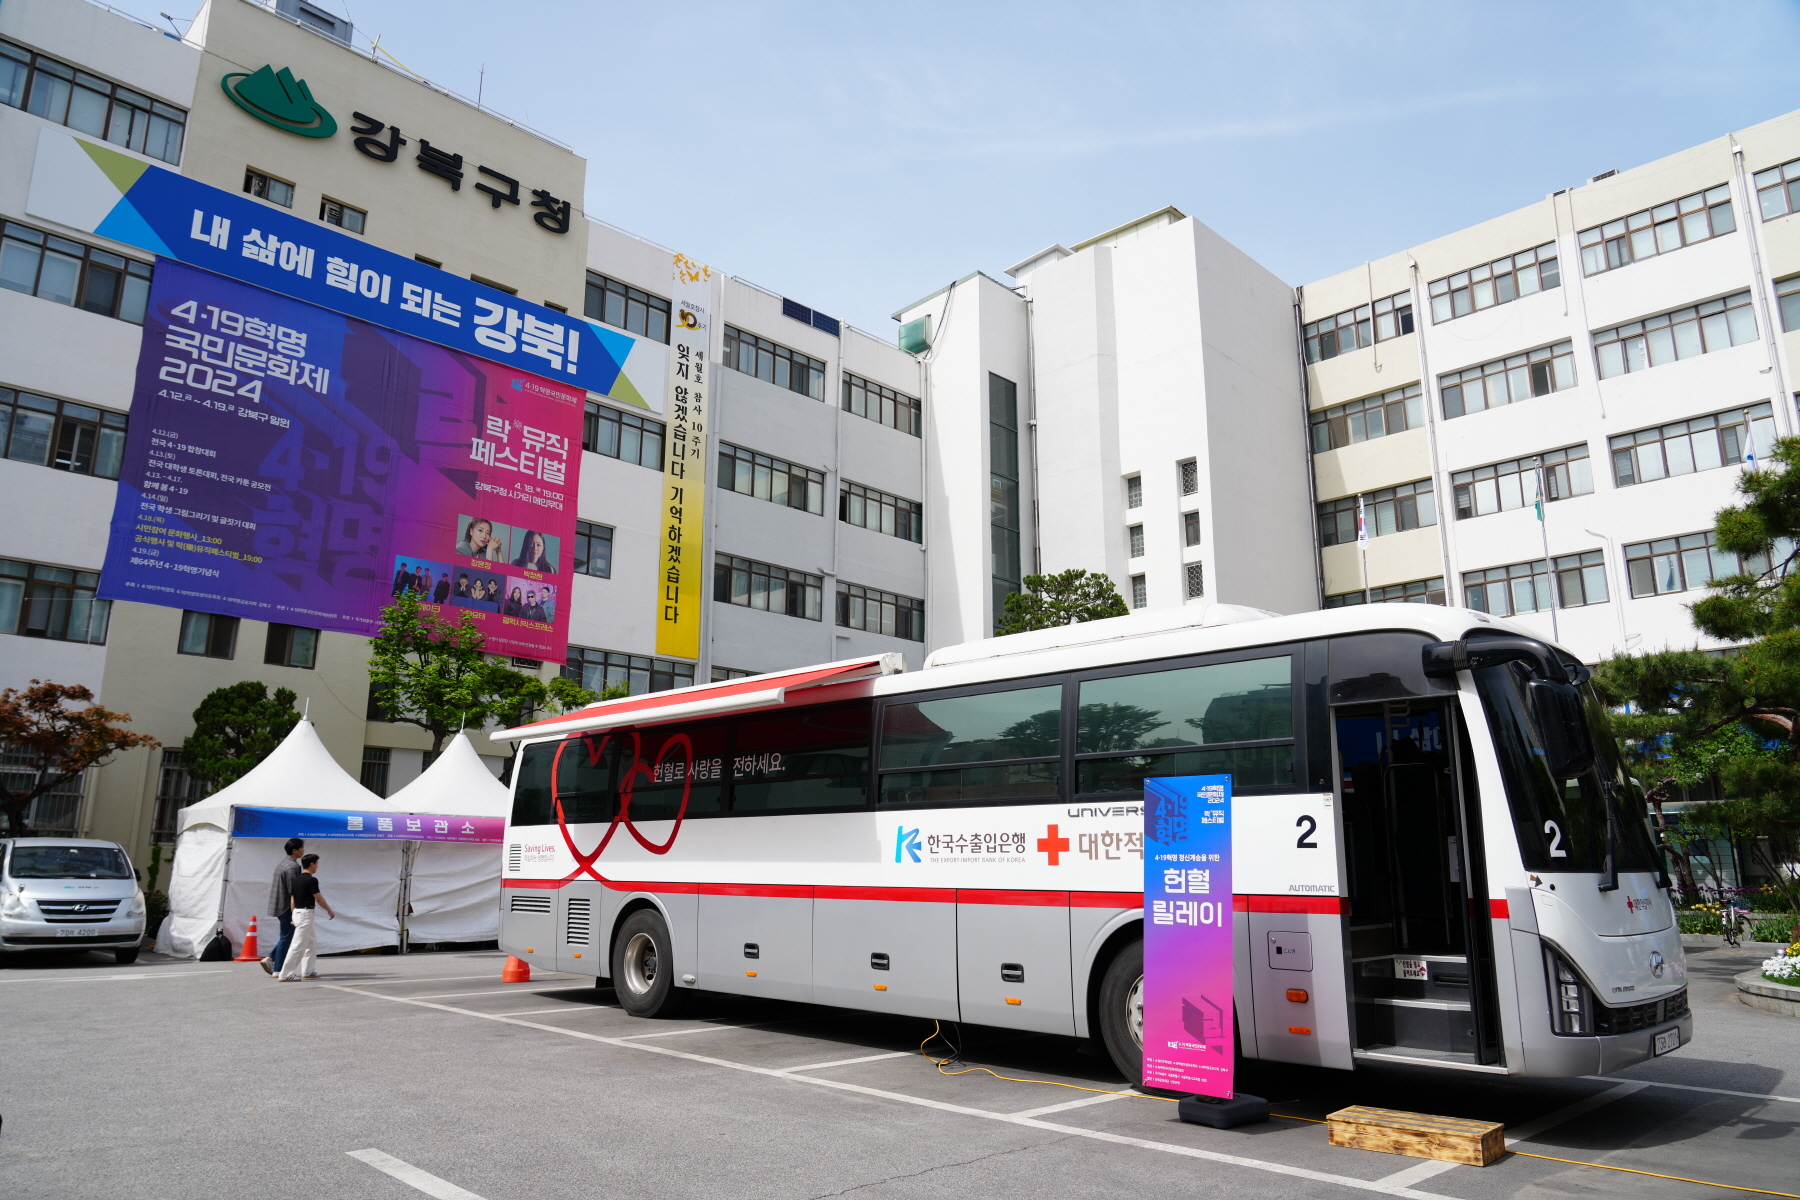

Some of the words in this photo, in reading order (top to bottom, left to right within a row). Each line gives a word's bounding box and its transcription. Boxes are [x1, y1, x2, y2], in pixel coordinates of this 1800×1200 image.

[350, 110, 572, 235] 강북구청
[189, 208, 231, 251] 내
[241, 226, 316, 280] 삶에
[325, 256, 392, 305] 힘이
[399, 280, 462, 329] 되는
[472, 296, 581, 376] 강북!
[164, 324, 331, 395] 국민문화제
[675, 342, 691, 381] 잊지
[693, 350, 705, 385] 세월호
[158, 356, 264, 404] 2024
[237, 406, 269, 423] 강북구
[269, 414, 291, 430] 일원
[692, 391, 703, 416] 참사
[486, 415, 512, 444] 락
[521, 425, 569, 461] 뮤직
[669, 385, 690, 480] 않겠습니다
[149, 449, 176, 461] 4.13.(토)
[150, 437, 167, 448] 전국
[187, 444, 217, 459] 합창대회
[469, 436, 566, 486] 페스티벌
[143, 480, 160, 490] 함께
[148, 458, 164, 469] 전국
[164, 462, 188, 474] 대학생
[220, 474, 236, 484] 전국
[235, 477, 250, 488] 카툰
[250, 480, 272, 492] 공모전
[474, 481, 508, 497] 강북구청
[507, 490, 532, 504] 사거리
[532, 496, 564, 512] 메인무대
[541, 488, 564, 501] 19:00
[135, 523, 167, 537] 시민참여
[139, 501, 157, 512] 전국
[157, 504, 173, 515] 학생
[172, 507, 211, 522] 그림그리기
[210, 514, 219, 524] 및
[219, 516, 242, 528] 글짓기
[241, 521, 257, 531] 대회
[134, 534, 166, 547] 공식행사
[129, 556, 164, 570] 제64주년
[664, 486, 685, 625] 기억하겠습니다
[502, 616, 555, 633] 갤럭시익스프레스
[653, 762, 685, 783] 헌혈로
[687, 758, 723, 780] 사랑을
[732, 752, 786, 778] 전하세요.
[927, 832, 1026, 854] 한국수출입은행
[1295, 814, 1318, 849] 2
[1543, 819, 1567, 858] 2
[524, 844, 542, 855] Saving
[1178, 853, 1208, 862] 정신계승을
[1208, 853, 1221, 862] 위한
[1163, 867, 1211, 895] 헌혈
[1288, 884, 1335, 893] AUTOMATIC
[1152, 900, 1223, 928] 릴레이
